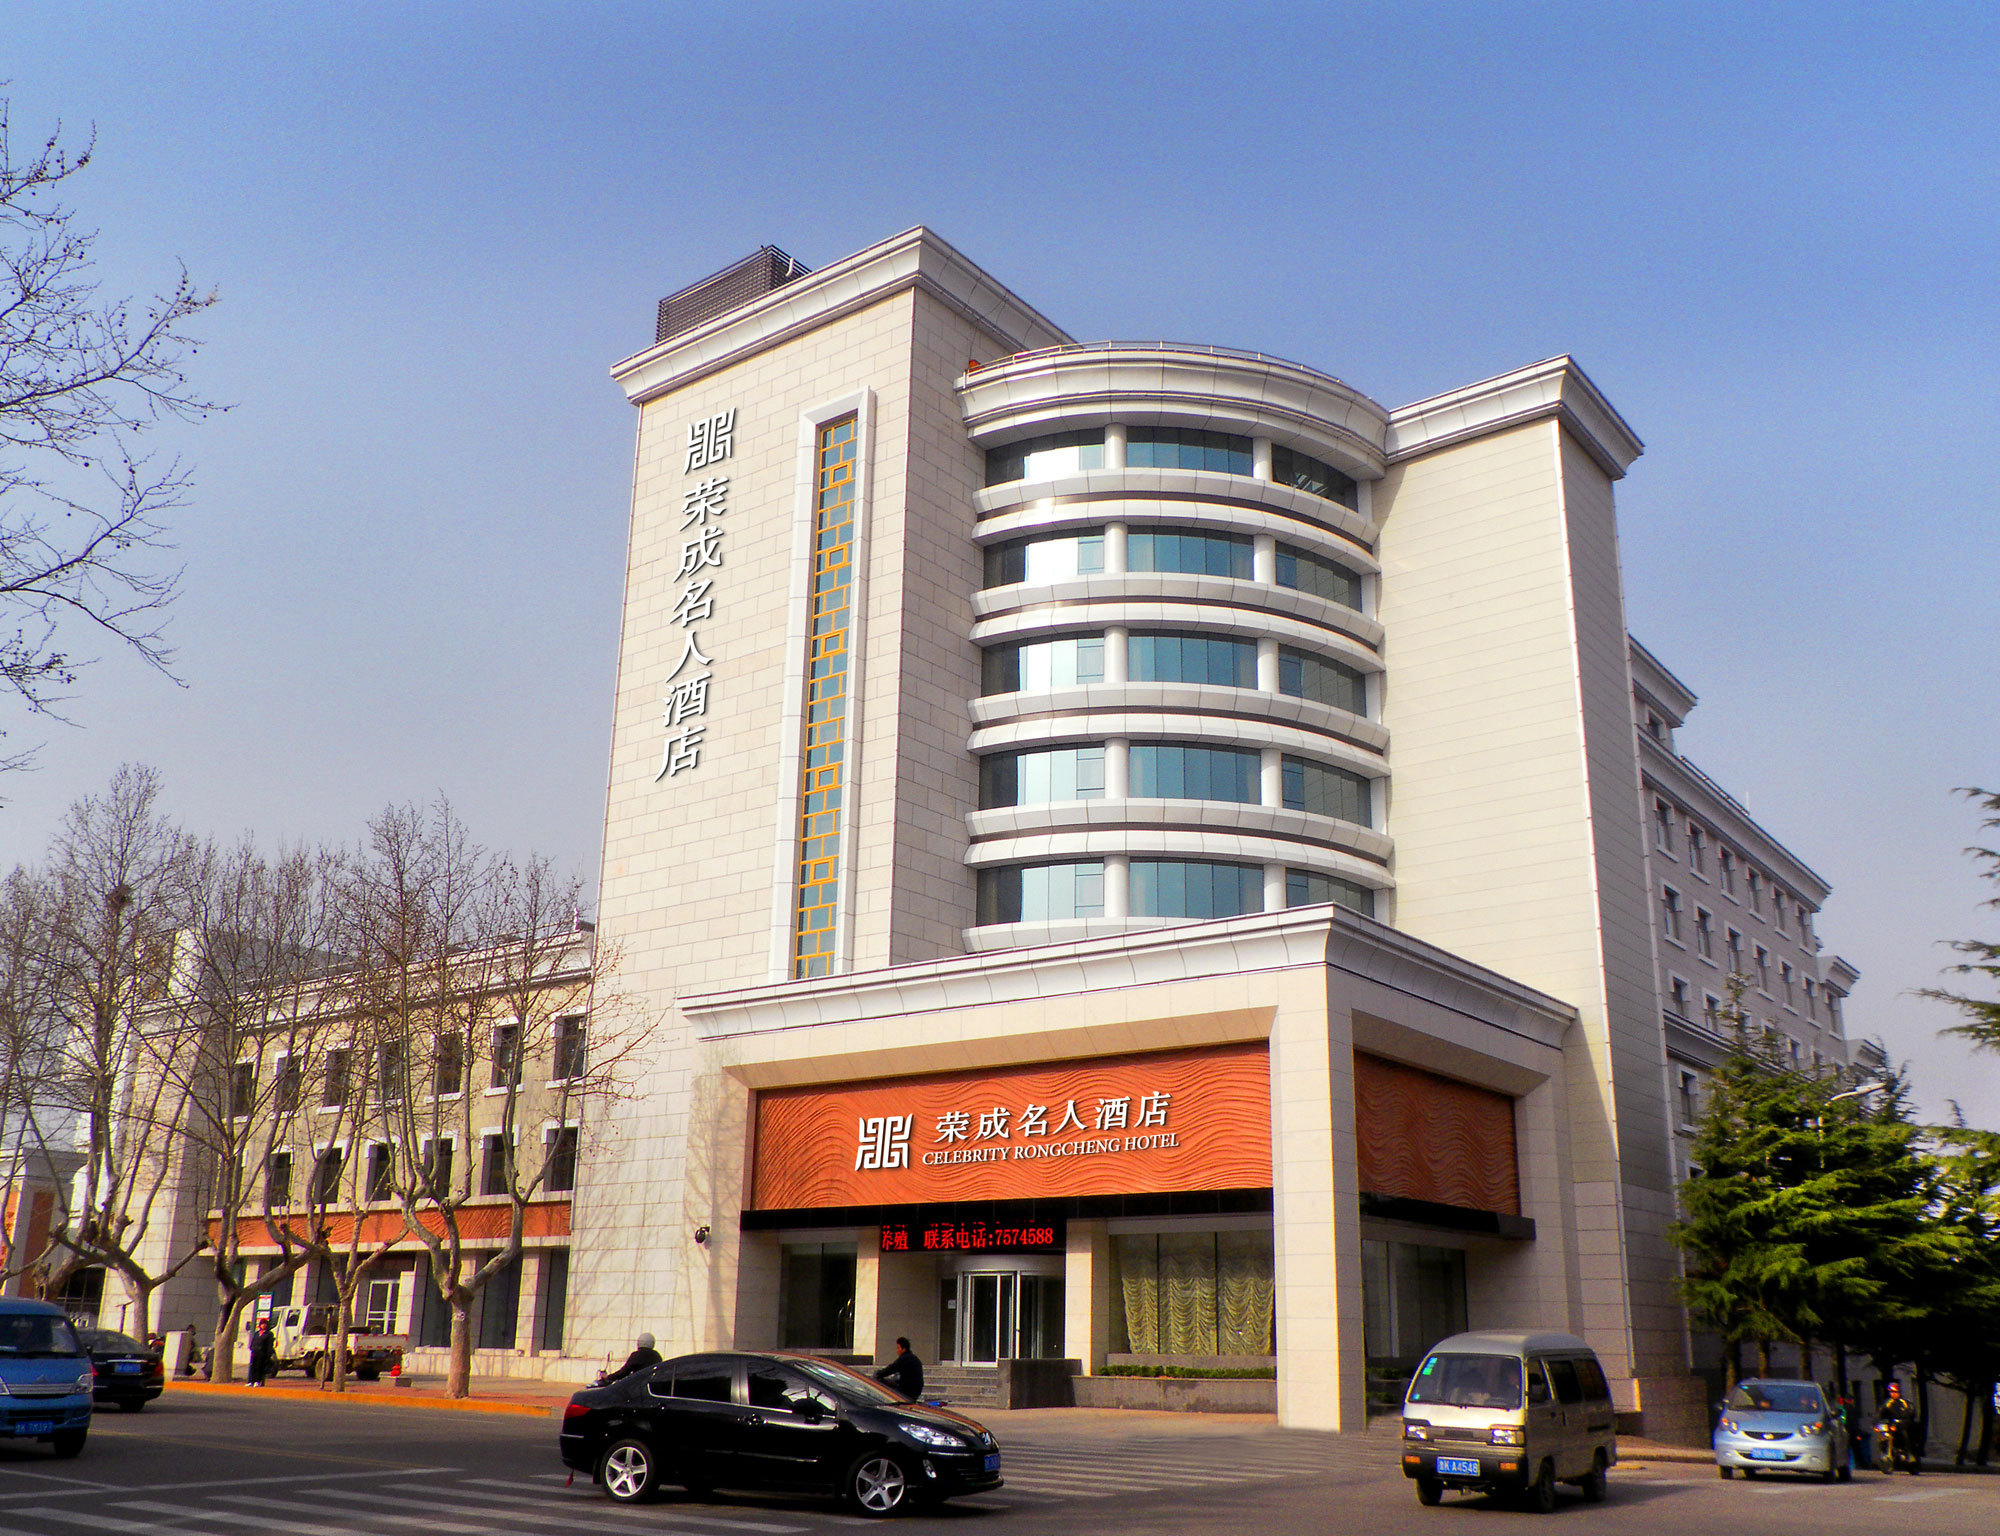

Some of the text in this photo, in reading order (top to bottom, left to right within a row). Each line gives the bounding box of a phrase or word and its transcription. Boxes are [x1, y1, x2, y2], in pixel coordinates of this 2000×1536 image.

[655, 476, 729, 782] 荣成名人酒店
[934, 1091, 1172, 1143] 荣成名人酒店
[922, 1133, 1179, 1166] CELEBRITY RONGCHENG HOTEL
